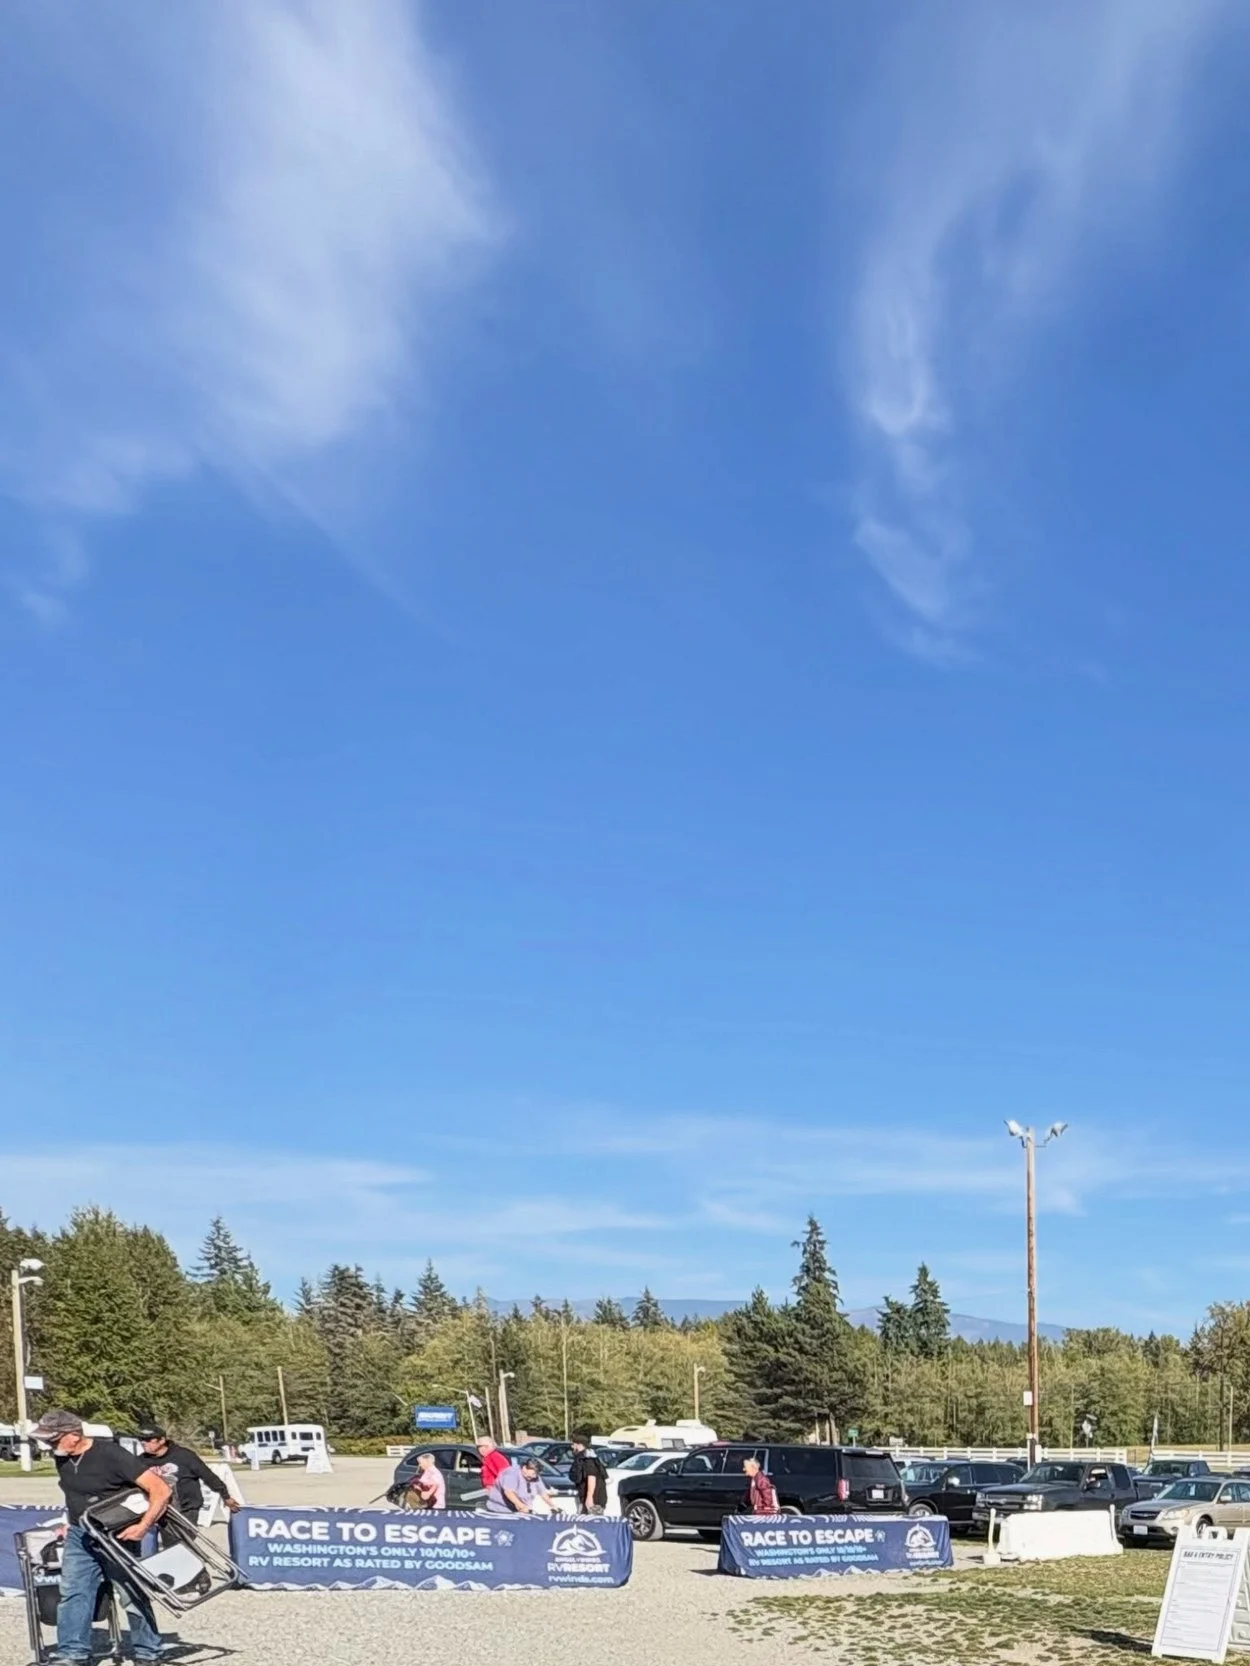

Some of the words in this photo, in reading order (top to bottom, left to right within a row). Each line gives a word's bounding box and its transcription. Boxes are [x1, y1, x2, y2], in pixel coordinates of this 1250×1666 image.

[248, 1518, 329, 1541] RACE
[336, 1522, 377, 1543] TO
[384, 1524, 492, 1546] ESCAPE
[741, 1530, 788, 1547] RACE
[790, 1529, 812, 1546] TO
[815, 1528, 875, 1545] ESCAPE
[267, 1543, 379, 1556] WASHINGTON'S
[381, 1546, 417, 1558] ONLY
[248, 1556, 271, 1567] RV
[273, 1556, 329, 1568] RESORT
[333, 1557, 353, 1568] AS
[356, 1558, 401, 1569] RATED
[404, 1559, 422, 1570] BY
[424, 1560, 493, 1571] GOODSAM
